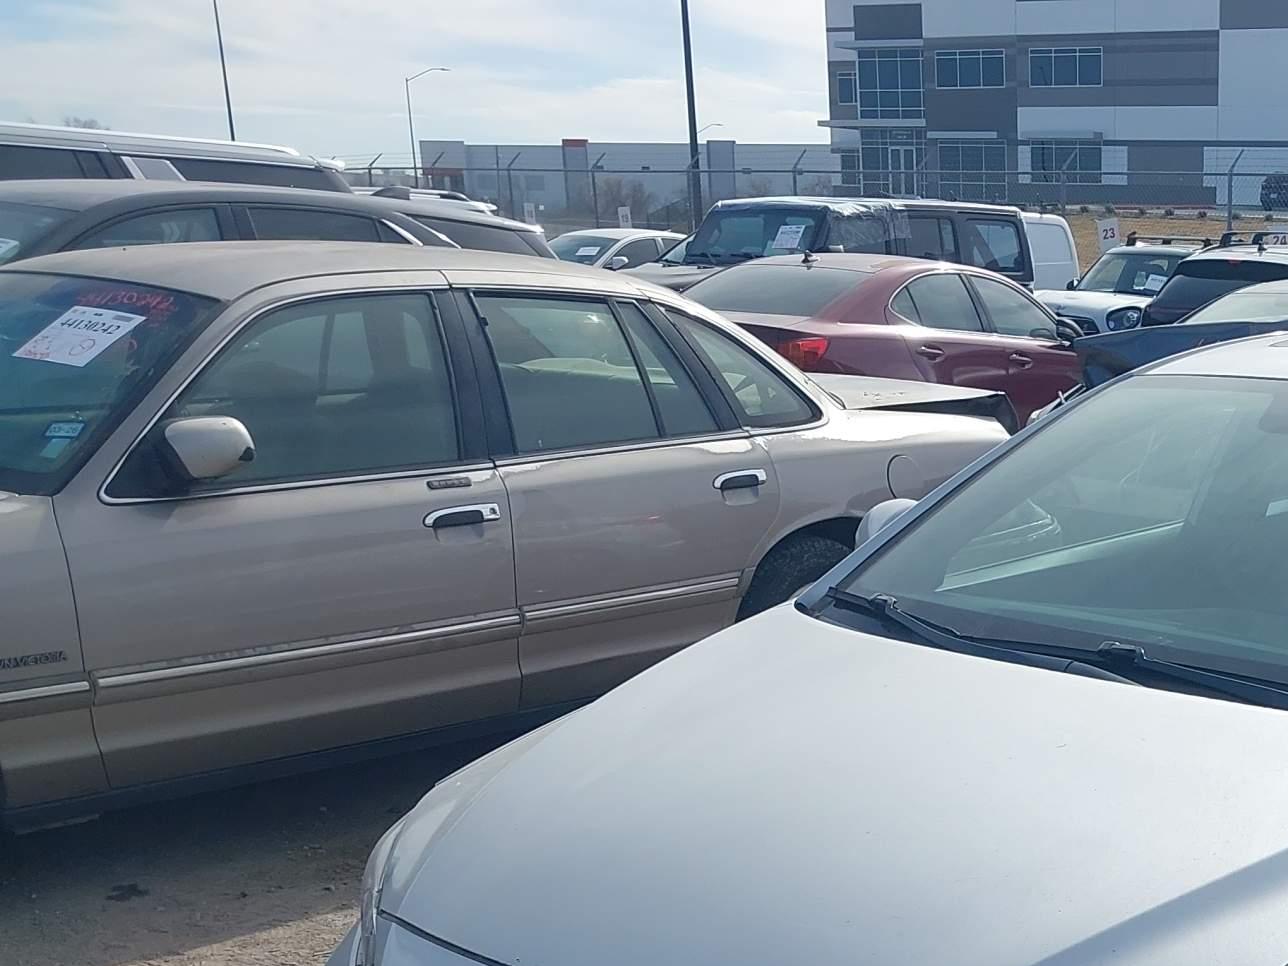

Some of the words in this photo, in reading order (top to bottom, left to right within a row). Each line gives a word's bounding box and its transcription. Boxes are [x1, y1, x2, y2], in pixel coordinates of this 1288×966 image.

[1102, 227, 1116, 240] 23
[1273, 235, 1288, 245] 24
[60, 317, 121, 335] 44130242
